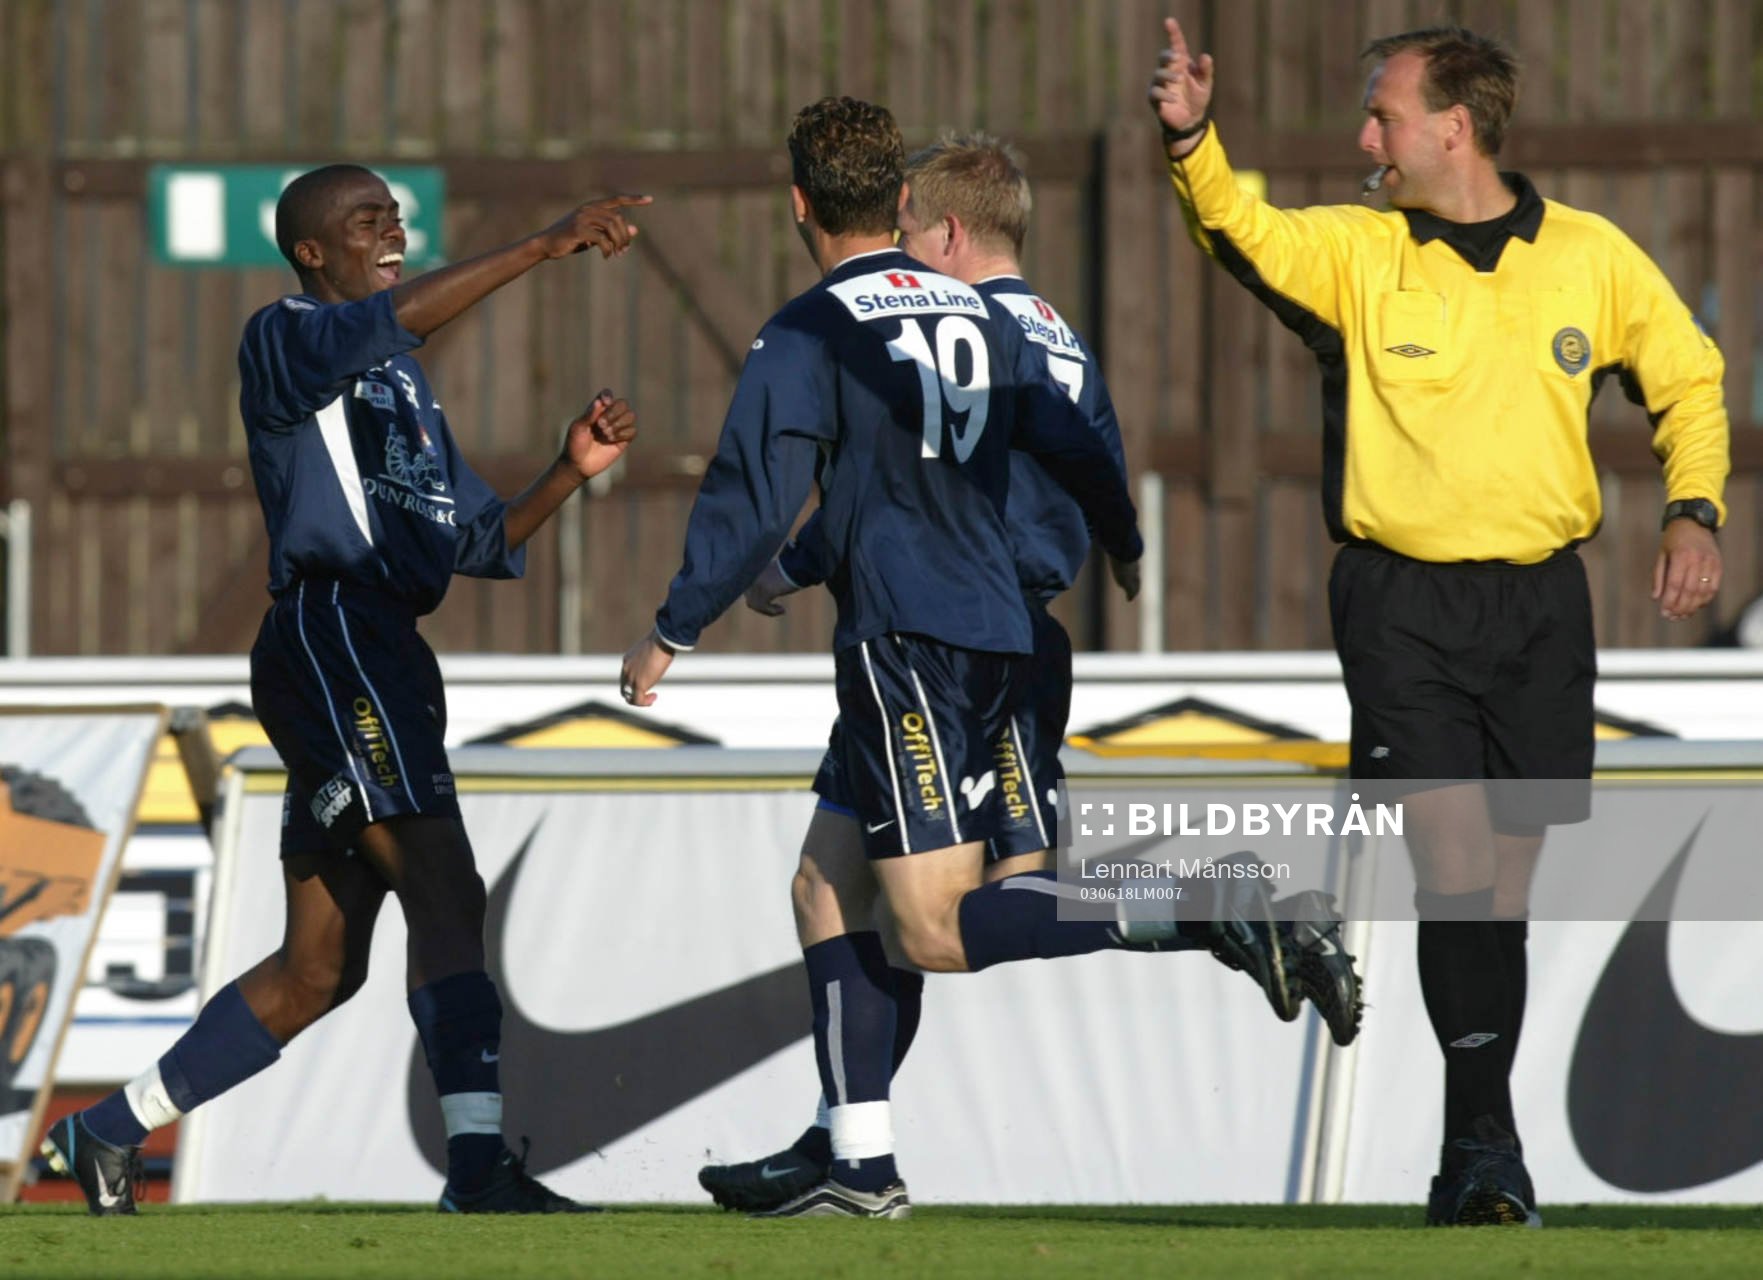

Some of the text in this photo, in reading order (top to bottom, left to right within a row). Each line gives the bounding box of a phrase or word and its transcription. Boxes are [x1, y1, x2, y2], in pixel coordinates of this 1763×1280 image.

[855, 290, 981, 313] Stena Line
[1017, 313, 1059, 346] Stea
[885, 315, 991, 465] 19
[353, 696, 399, 788] OffiTech
[902, 712, 945, 812] OffiTech
[995, 726, 1030, 819] ffiTech
